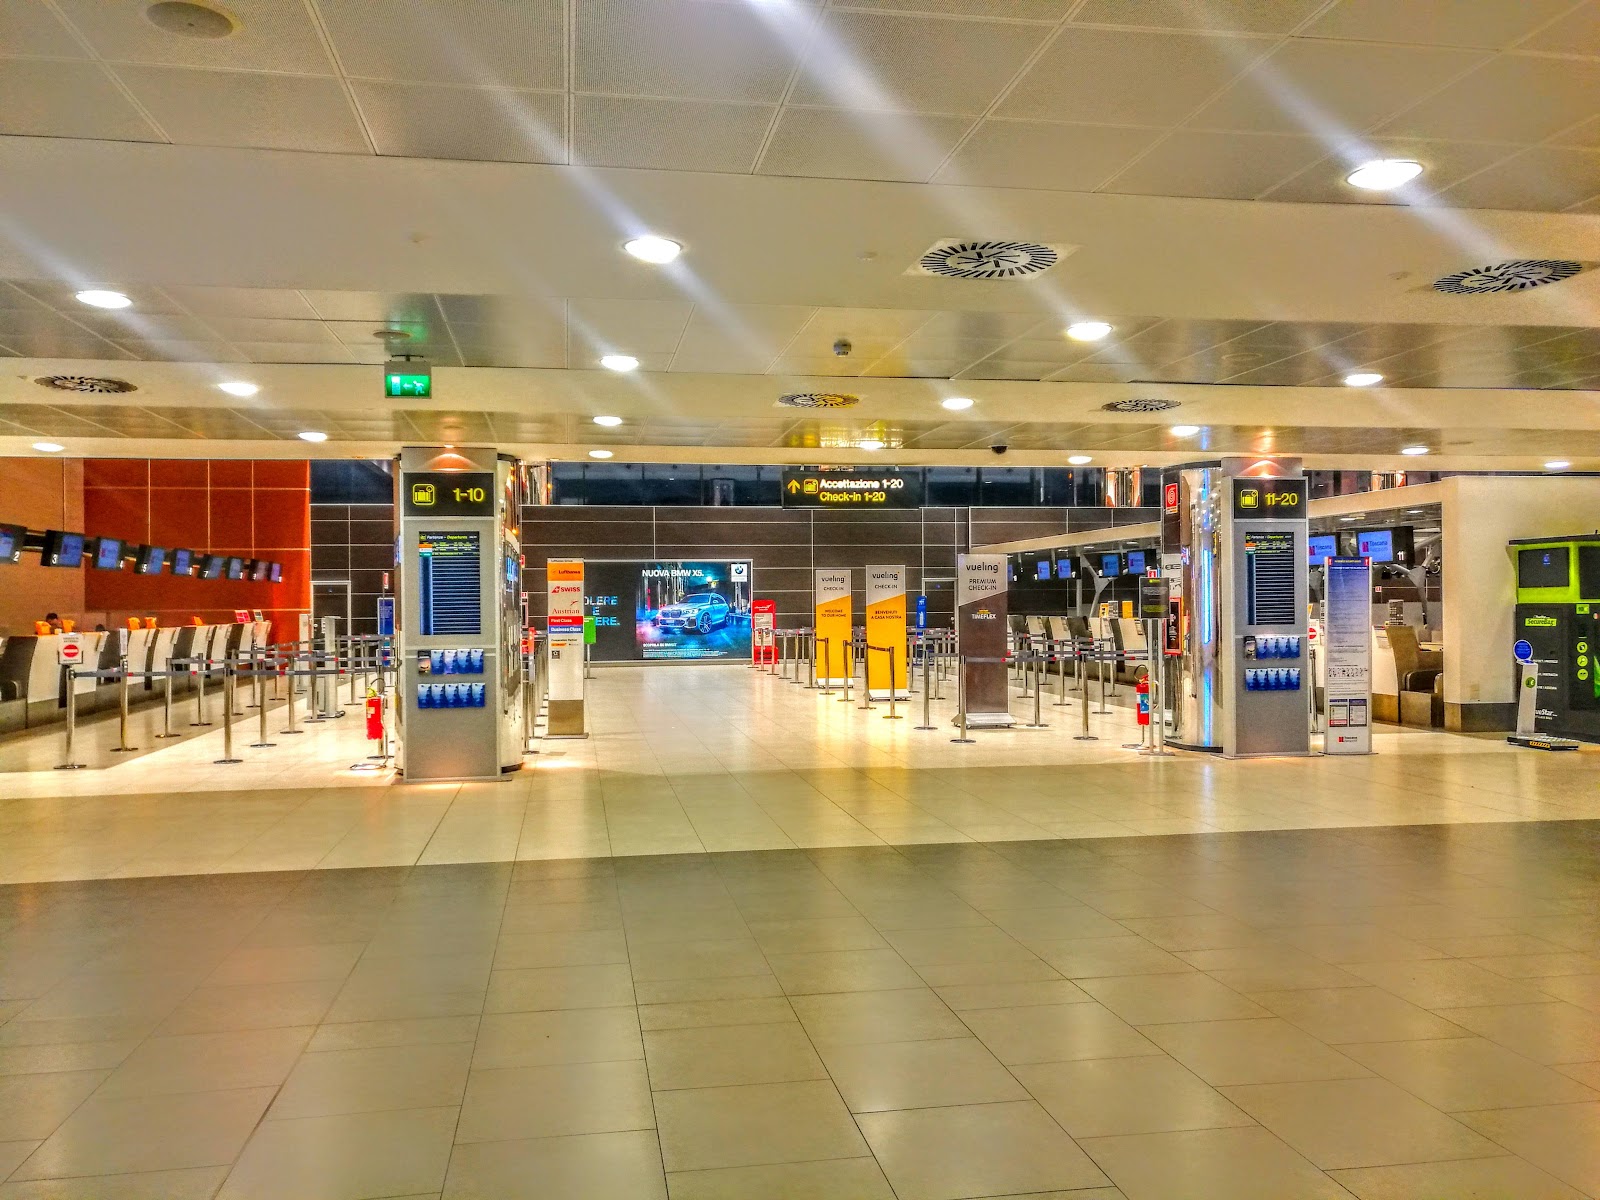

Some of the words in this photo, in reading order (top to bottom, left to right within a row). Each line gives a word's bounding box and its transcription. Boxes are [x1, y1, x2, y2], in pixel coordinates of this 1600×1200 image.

[820, 479, 880, 489] Accettazione
[882, 479, 904, 489] 1-20
[452, 487, 485, 502] 1-10
[820, 491, 862, 501] Check-in
[864, 491, 886, 501] 1-20
[1265, 492, 1298, 506] 11-20
[13, 551, 20, 562] 2
[52, 554, 59, 564] 3
[1397, 551, 1405, 561] 11
[142, 564, 148, 573] 5
[966, 561, 999, 574] vueling
[642, 569, 669, 577] NUOVA
[671, 569, 691, 577] BMW
[692, 569, 704, 577] X5.
[872, 570, 899, 581] vueling
[821, 575, 845, 584] vueling
[552, 607, 580, 615] Austrian
[1527, 618, 1555, 626] SecureBag
